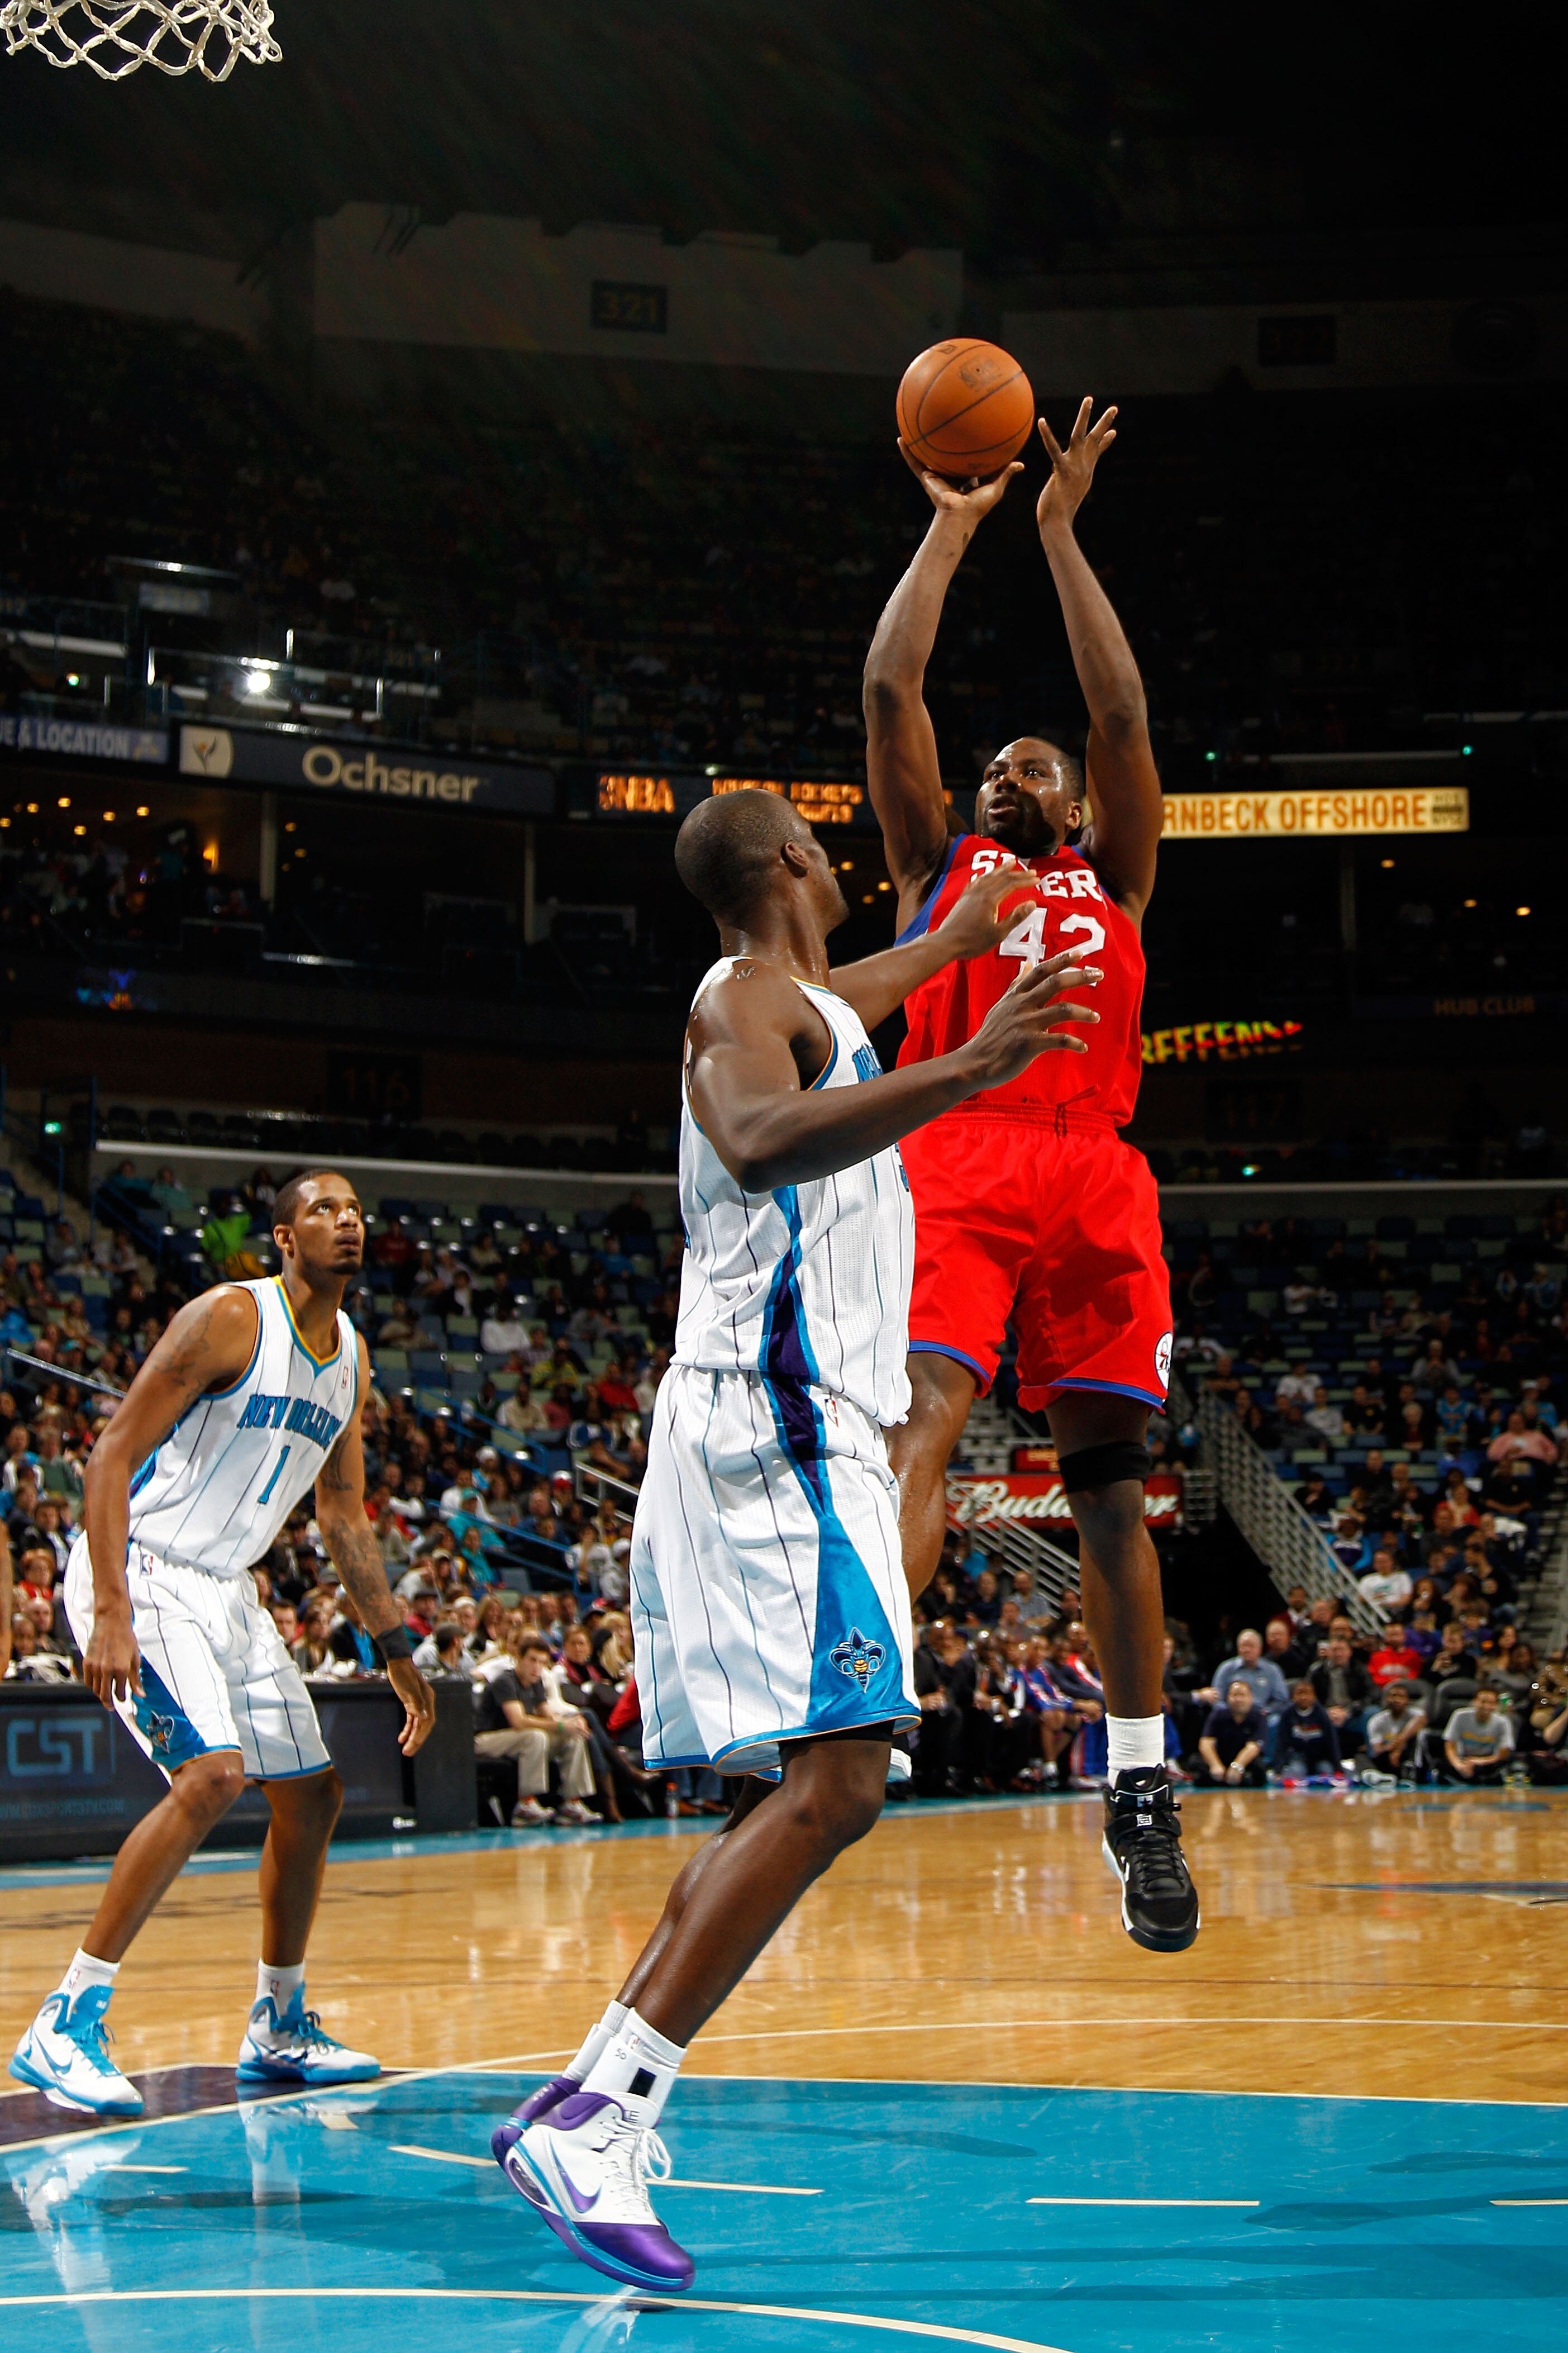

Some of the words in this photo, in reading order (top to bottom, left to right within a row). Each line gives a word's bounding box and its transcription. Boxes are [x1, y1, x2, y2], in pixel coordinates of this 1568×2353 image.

[36, 721, 129, 759] LOCATION
[302, 745, 480, 803] Ochsner
[1280, 794, 1426, 830] OFFSHORE
[999, 907, 1105, 987] 42
[1432, 997, 1479, 1018] HUB
[1481, 994, 1536, 1017] CLUB
[236, 1394, 291, 1429] NEW
[257, 1445, 291, 1505] 1
[7, 1718, 103, 1777] CST
